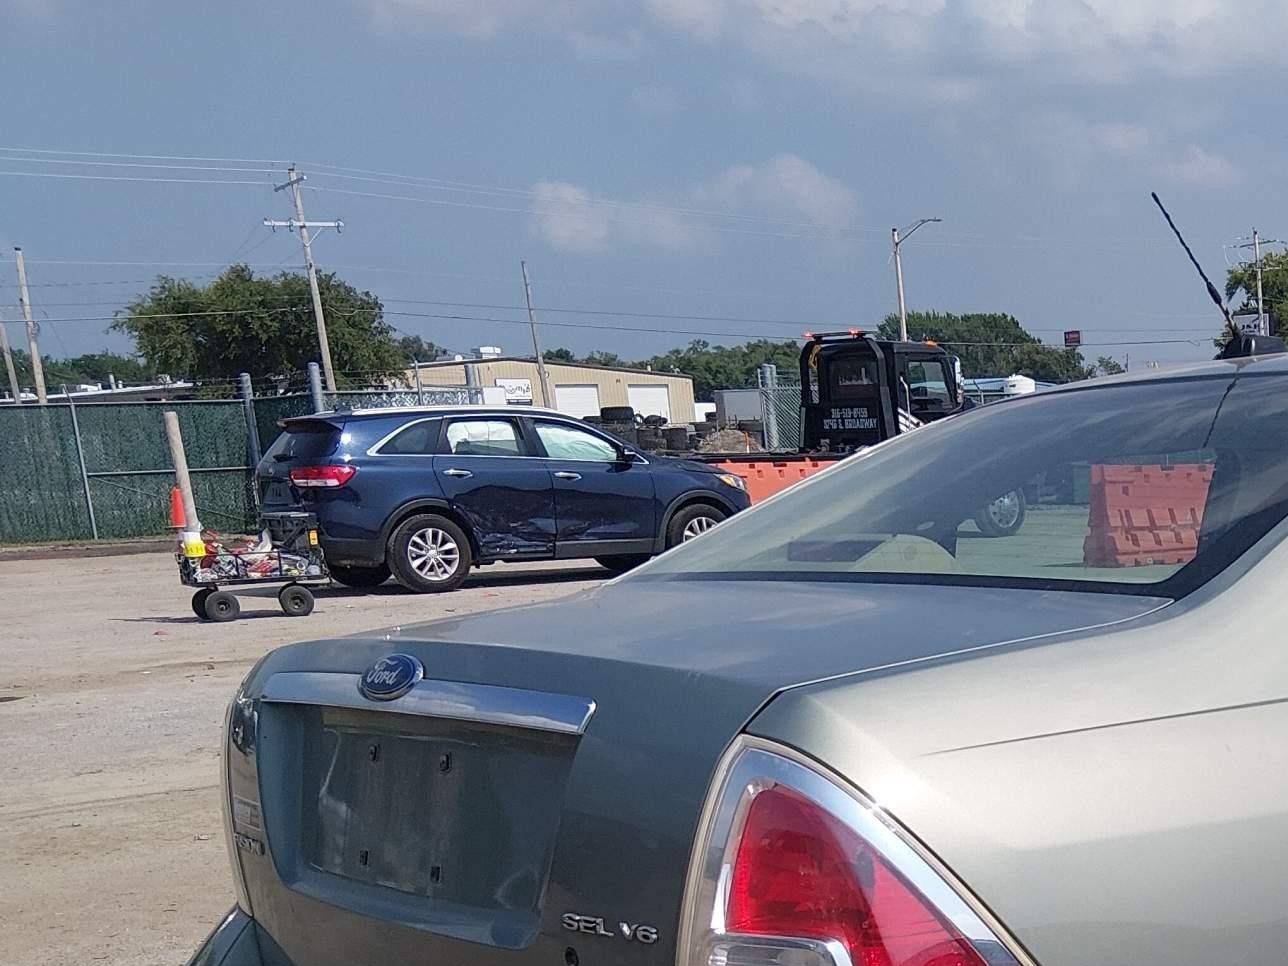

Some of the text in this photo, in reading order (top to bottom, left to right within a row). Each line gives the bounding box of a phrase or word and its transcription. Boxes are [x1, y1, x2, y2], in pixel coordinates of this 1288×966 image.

[365, 658, 404, 686] Ford
[560, 912, 659, 945] SEL V6
